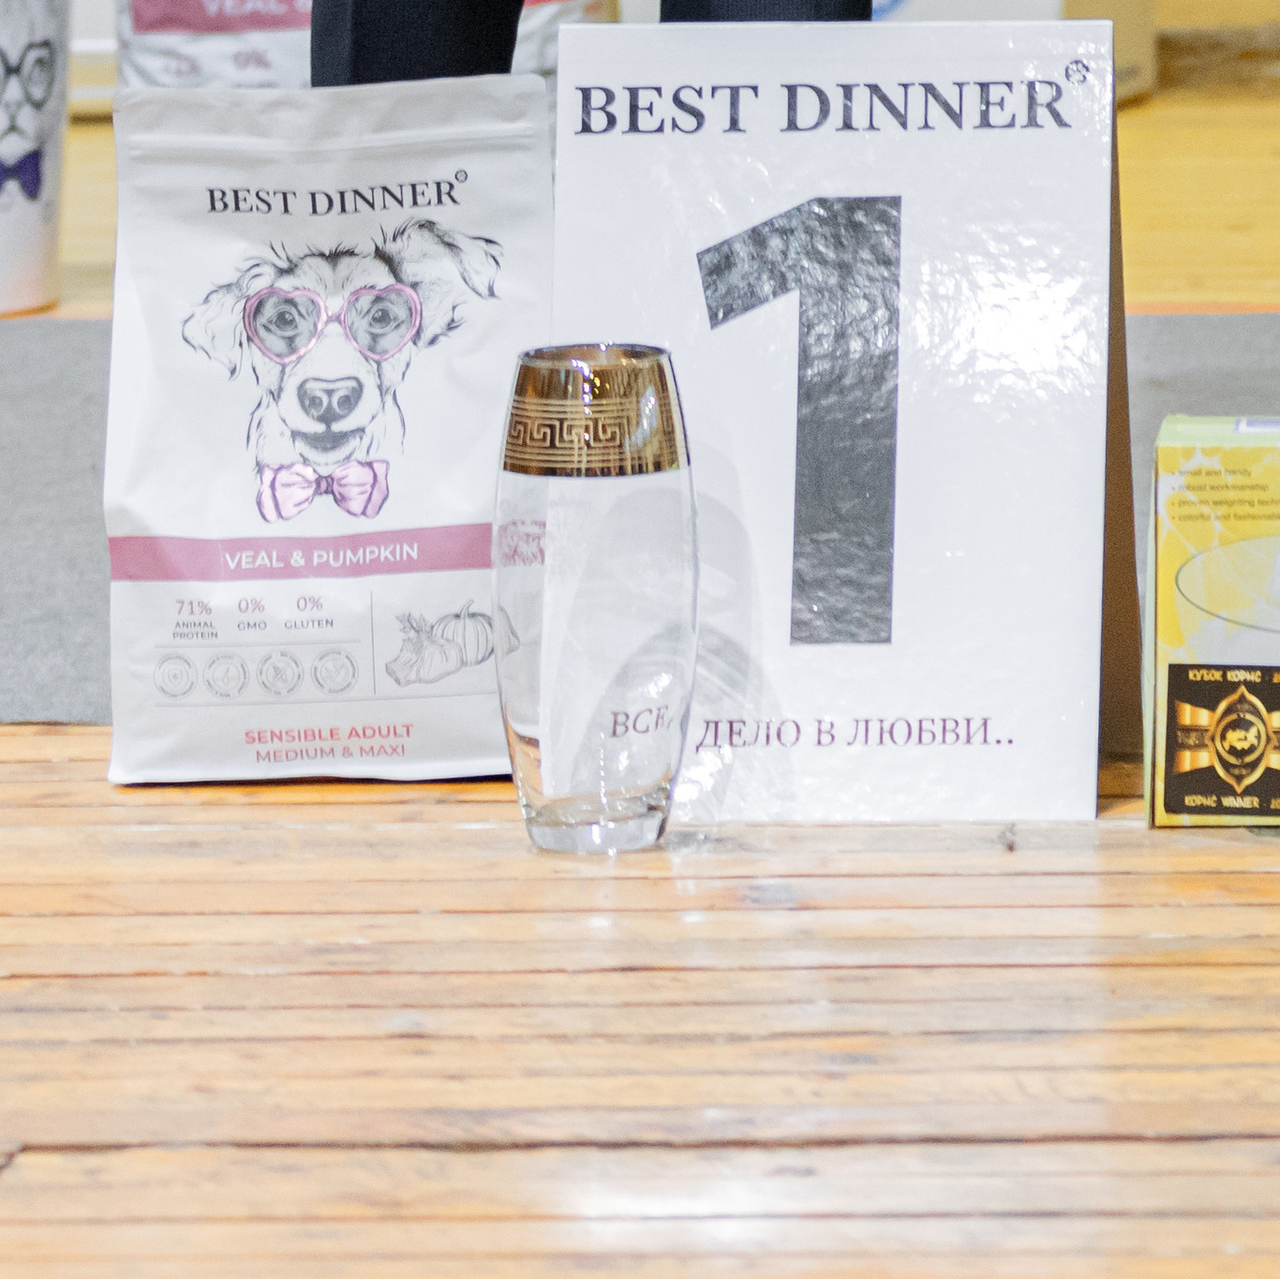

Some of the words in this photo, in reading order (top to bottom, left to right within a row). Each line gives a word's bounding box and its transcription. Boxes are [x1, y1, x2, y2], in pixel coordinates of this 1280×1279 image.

[574, 84, 759, 135] BEST
[779, 79, 1073, 134] DINNER
[206, 186, 297, 216] BEST
[309, 179, 461, 216] DINNER
[696, 195, 903, 645] 1
[225, 549, 285, 570] VEAL
[290, 549, 306, 568] &
[313, 542, 419, 568] PUMPKIN
[175, 599, 213, 617] 71%
[237, 597, 266, 614] 0%
[296, 595, 324, 612] 0%
[172, 631, 219, 640] PROTEIN
[174, 621, 217, 630] ANIMAL
[237, 620, 268, 632] GMO
[284, 618, 334, 630] GLUTEN
[244, 727, 341, 745] SENSIBLE
[347, 723, 414, 740] ADULT
[695, 718, 801, 753] ДЕЛО
[814, 717, 837, 747] В
[256, 747, 335, 764] MEDIUM
[341, 745, 354, 759] &
[359, 743, 406, 758] MAXI
